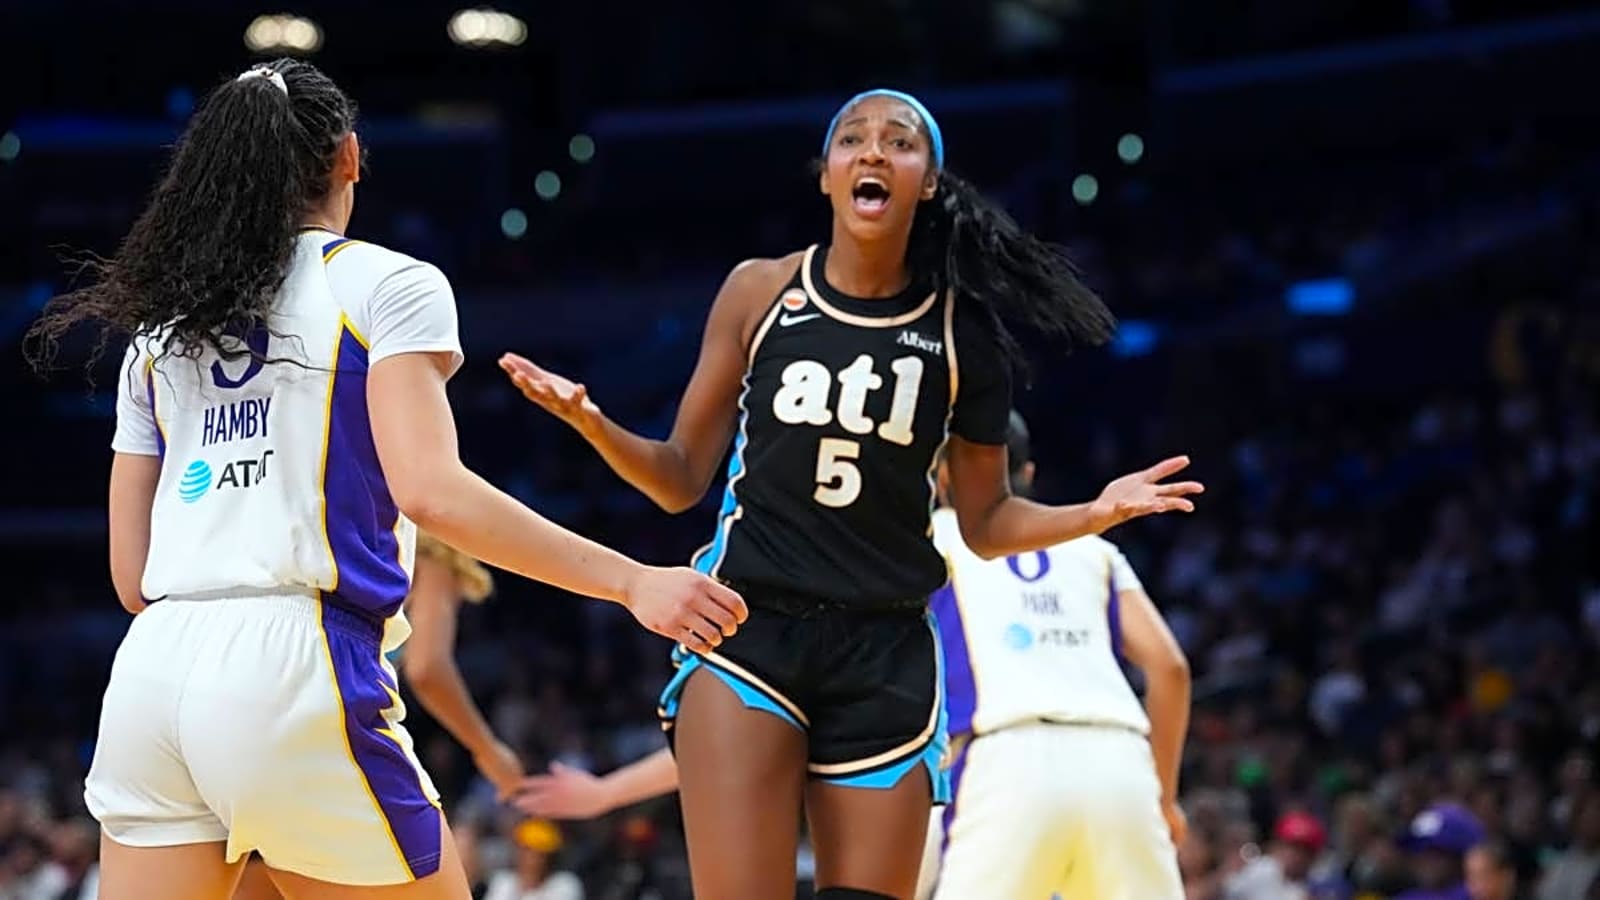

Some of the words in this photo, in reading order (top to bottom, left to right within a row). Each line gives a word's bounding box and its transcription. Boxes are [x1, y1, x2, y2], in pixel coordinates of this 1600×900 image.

[896, 331, 943, 355] Albert
[202, 397, 271, 447] HAMBY
[772, 354, 924, 446] atl
[813, 437, 862, 508] 5
